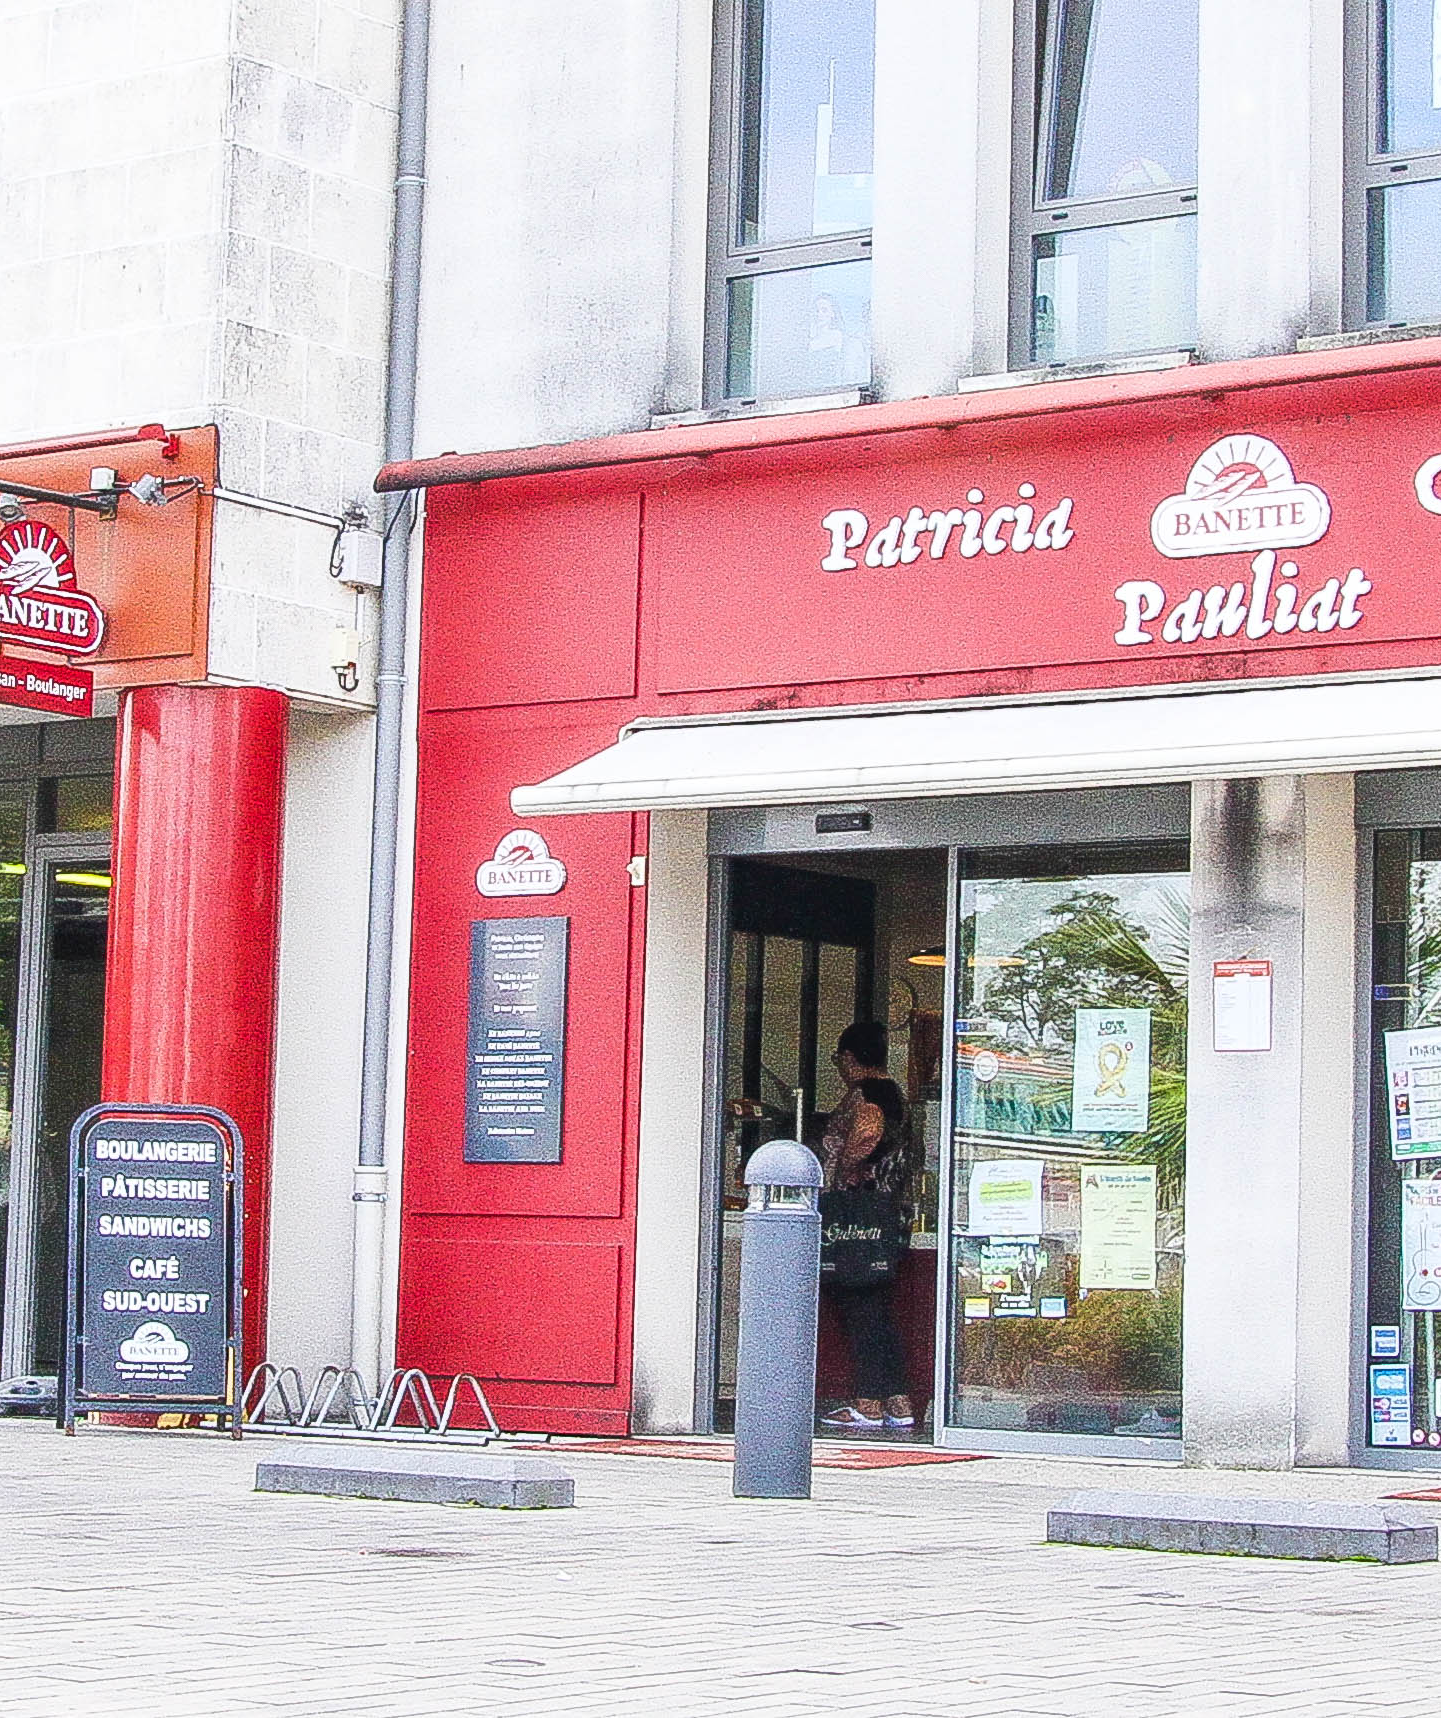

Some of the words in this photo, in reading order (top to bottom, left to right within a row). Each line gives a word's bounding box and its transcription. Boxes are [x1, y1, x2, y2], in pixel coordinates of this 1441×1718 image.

[822, 483, 1075, 572] Patricia
[1172, 502, 1306, 536] BANETTE
[1113, 548, 1372, 646] Pauliat
[25, 677, 87, 702] Boulanger
[488, 870, 553, 886] BANETTE
[96, 1139, 216, 1162] BOULANGERIE
[102, 1174, 209, 1200] PÂTISSERIE
[99, 1215, 211, 1238] SANDWICHS
[129, 1256, 179, 1279] CAFÉ
[102, 1291, 210, 1313] SUD-OUEST
